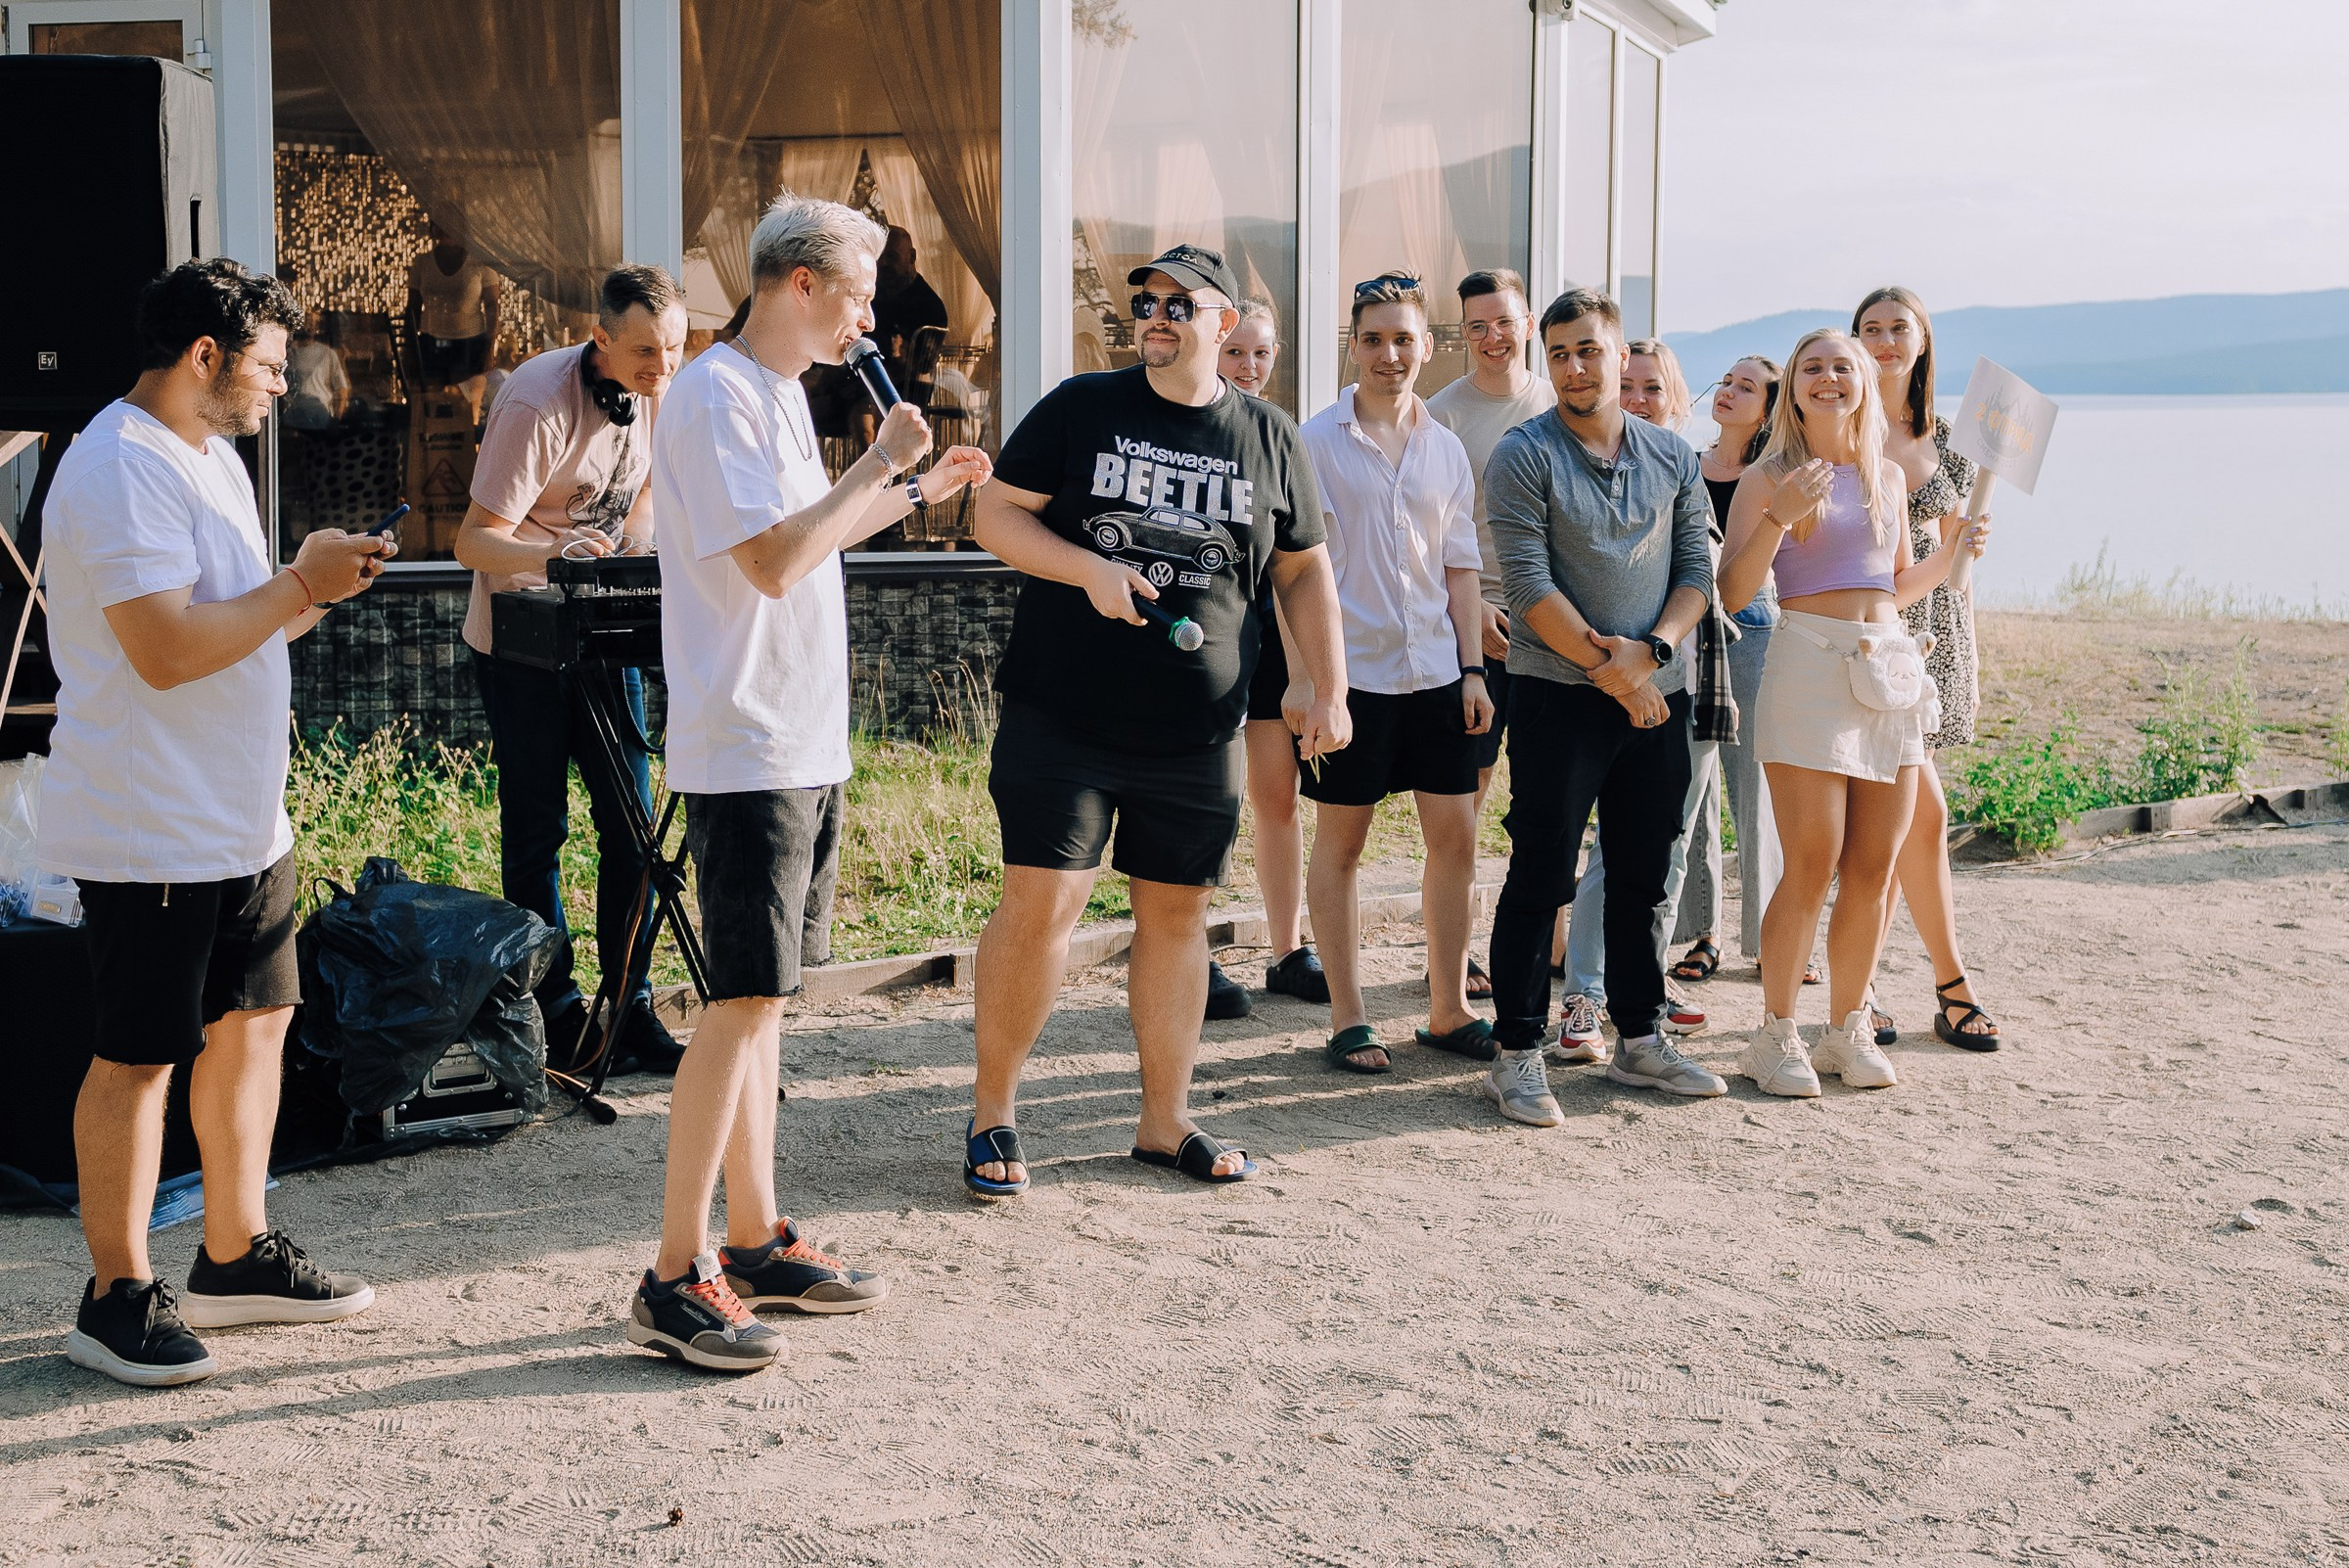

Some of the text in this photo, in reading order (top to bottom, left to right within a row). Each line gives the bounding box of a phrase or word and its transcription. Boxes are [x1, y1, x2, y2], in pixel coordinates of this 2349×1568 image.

[1115, 435, 1238, 475] Volkswagen
[1090, 453, 1254, 526] BEETLE
[1178, 574, 1212, 586] CLASSIC
